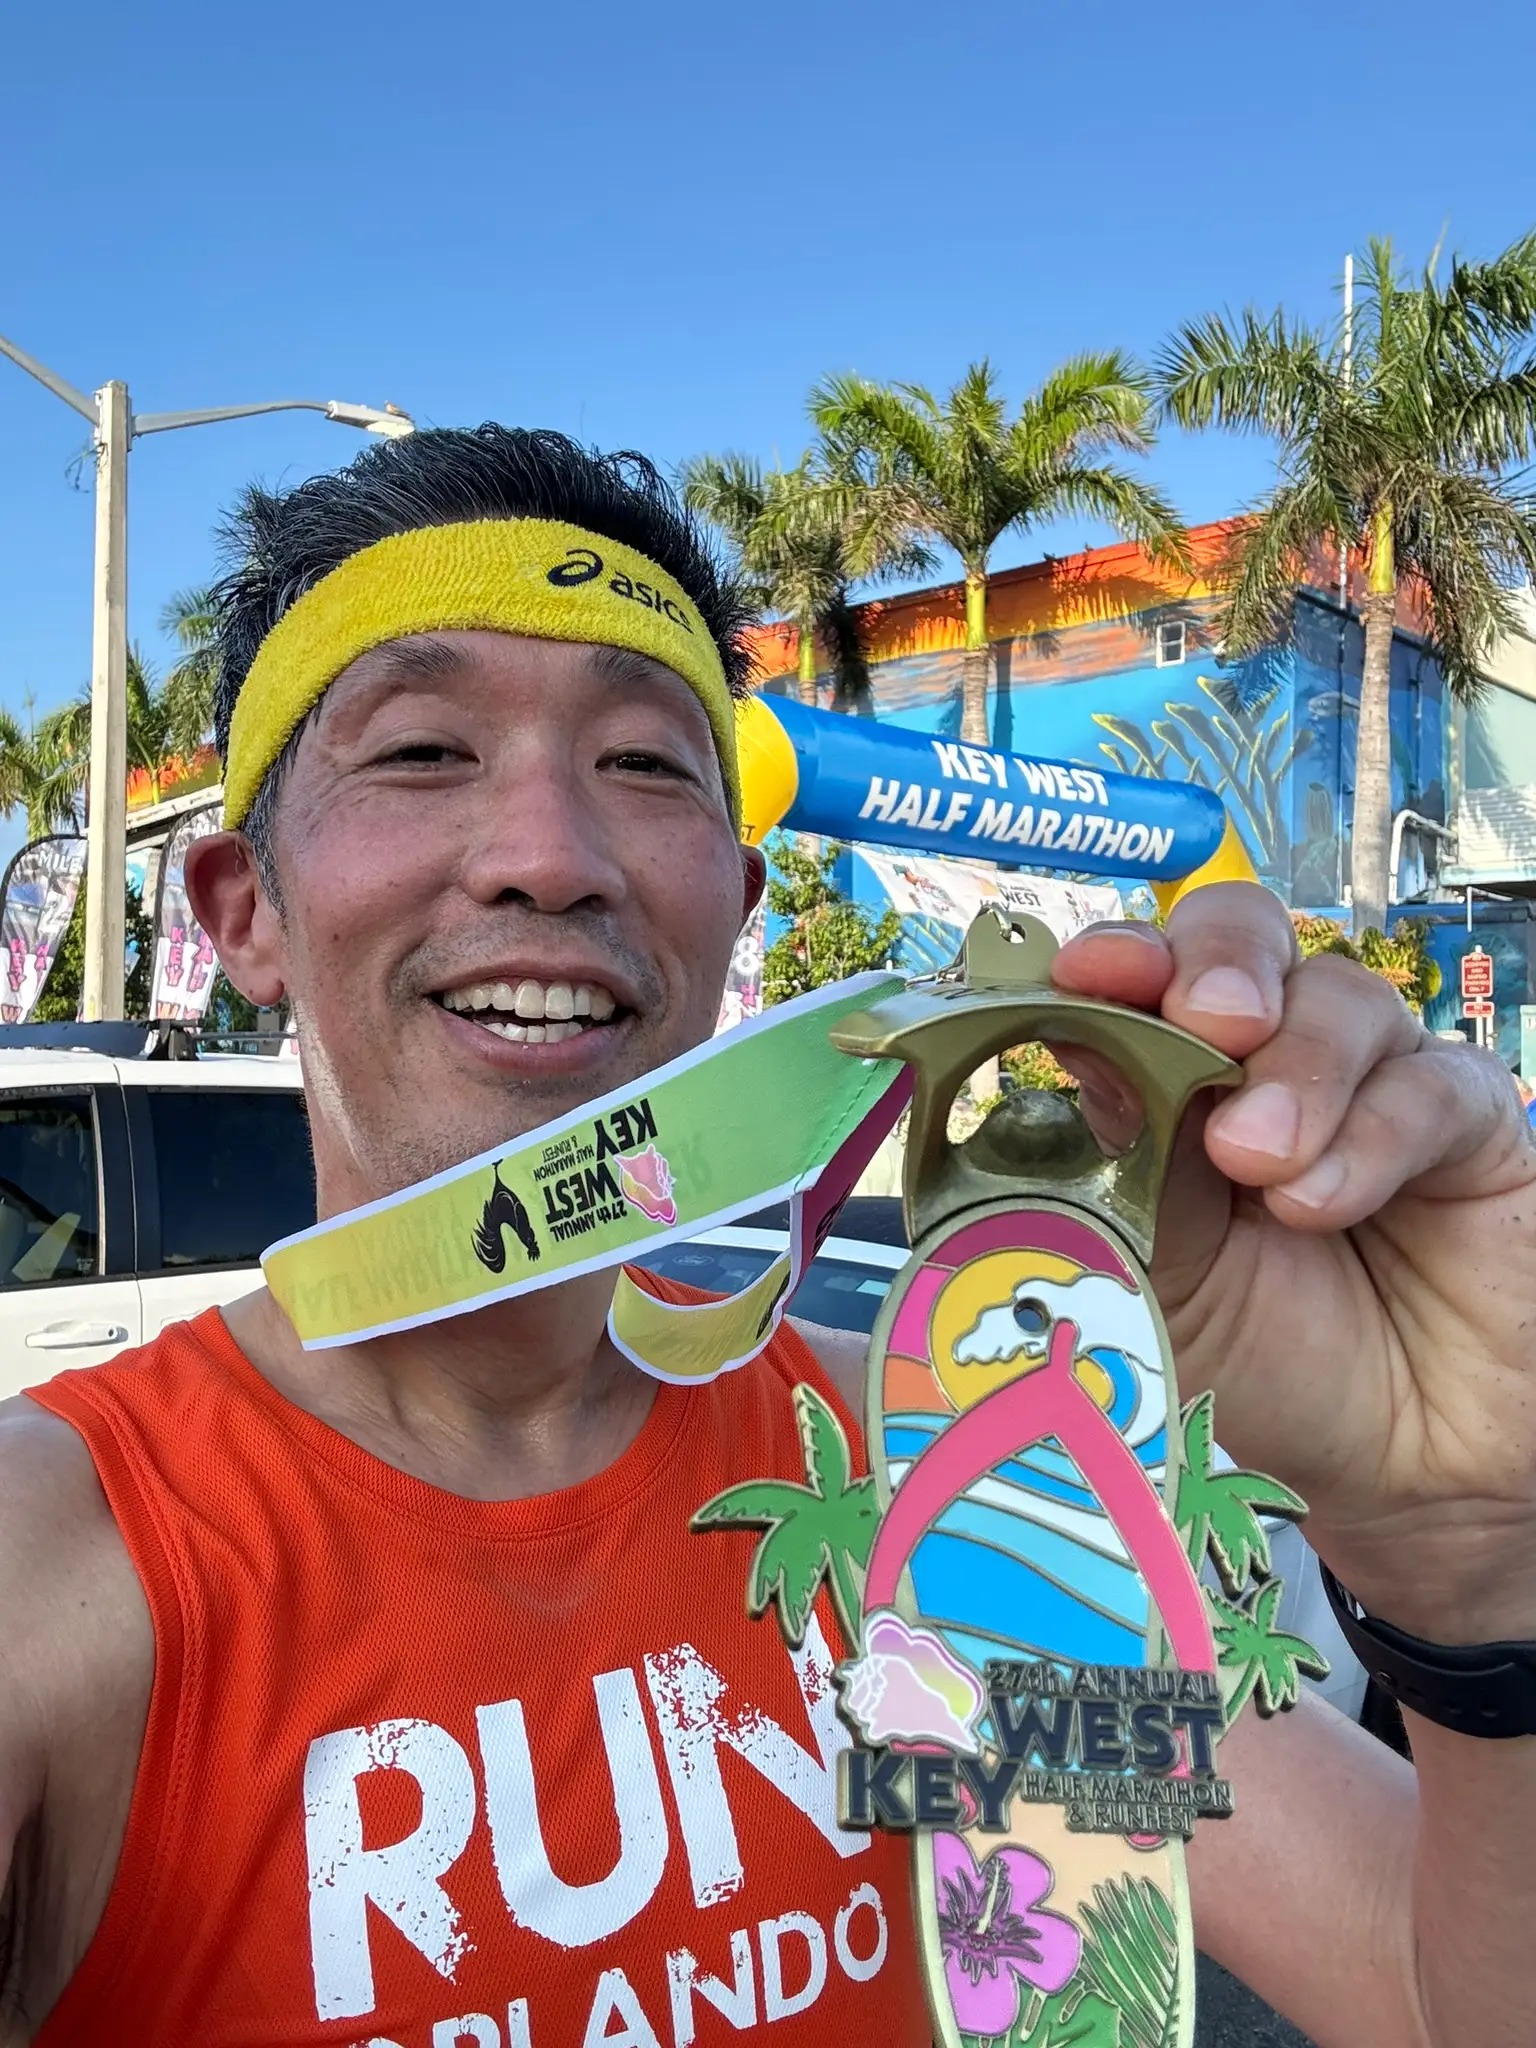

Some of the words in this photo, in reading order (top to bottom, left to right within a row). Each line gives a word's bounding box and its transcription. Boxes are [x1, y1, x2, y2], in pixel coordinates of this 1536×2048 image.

[931, 740, 1010, 789] KEY
[1014, 758, 1109, 807] WEST
[858, 776, 974, 832] HALF
[968, 799, 1175, 865] MARATHON
[1000, 889, 1042, 907] WEST
[541, 1140, 572, 1162] RUNFEST
[576, 1144, 595, 1165] HALF
[594, 1098, 658, 1161] KEY
[533, 1153, 578, 1182] MARATHON
[543, 1161, 622, 1225] WEST
[550, 1215, 597, 1242] ANNUAL
[597, 1200, 628, 1224] 27th
[986, 1660, 1068, 1695] 27th
[1069, 1664, 1221, 1702] ANNUAL
[989, 1697, 1223, 1777] WEST
[845, 1750, 1023, 1831] KEY
[1022, 1774, 1084, 1800] HALF
[1091, 1777, 1233, 1809] MARATHON
[1068, 1803, 1085, 1825] &
[1091, 1801, 1197, 1832] RUNFEST
[303, 1611, 874, 2023] RUN
[347, 1882, 888, 2048] ANDO
